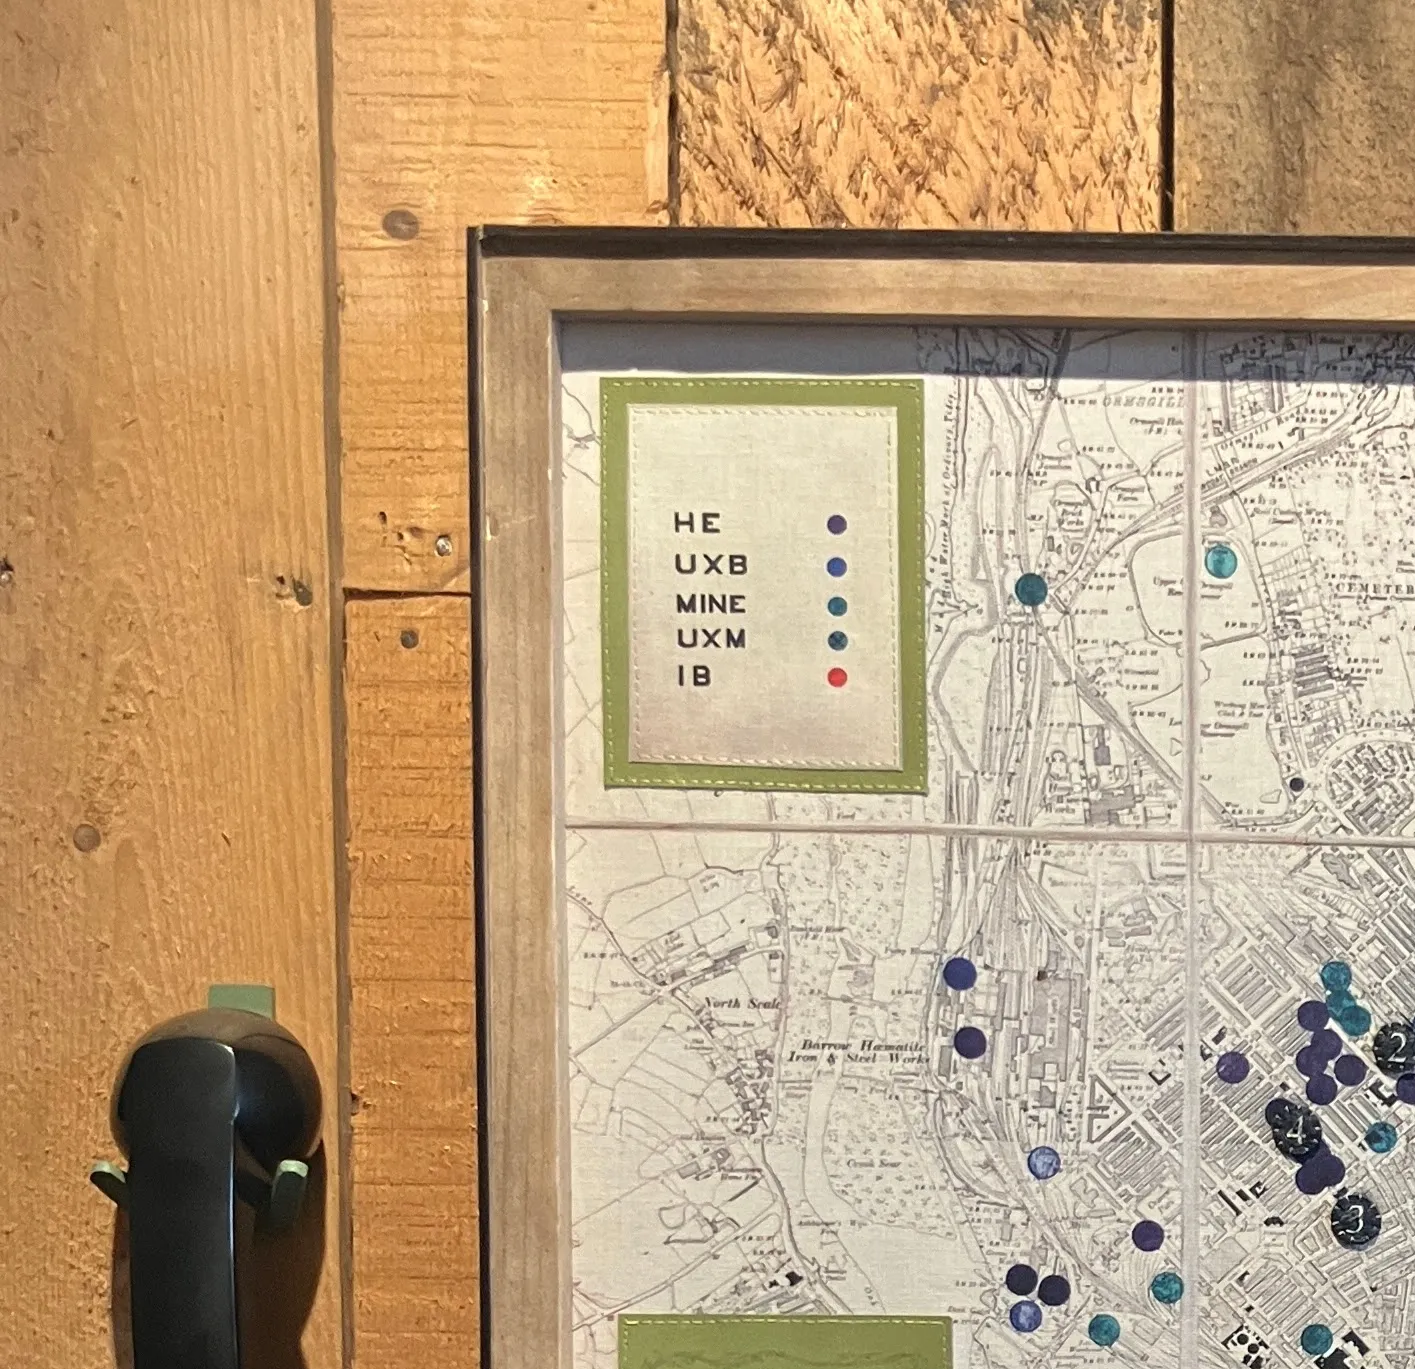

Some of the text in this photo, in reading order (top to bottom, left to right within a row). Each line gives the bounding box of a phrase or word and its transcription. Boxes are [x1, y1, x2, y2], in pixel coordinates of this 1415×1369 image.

[673, 512, 721, 534] HE
[674, 554, 748, 576] UXB
[675, 594, 746, 615] MINE
[677, 629, 747, 649] UXM
[678, 665, 712, 687] IB
[1387, 1032, 1408, 1062] 2
[1349, 1204, 1365, 1234] 3
